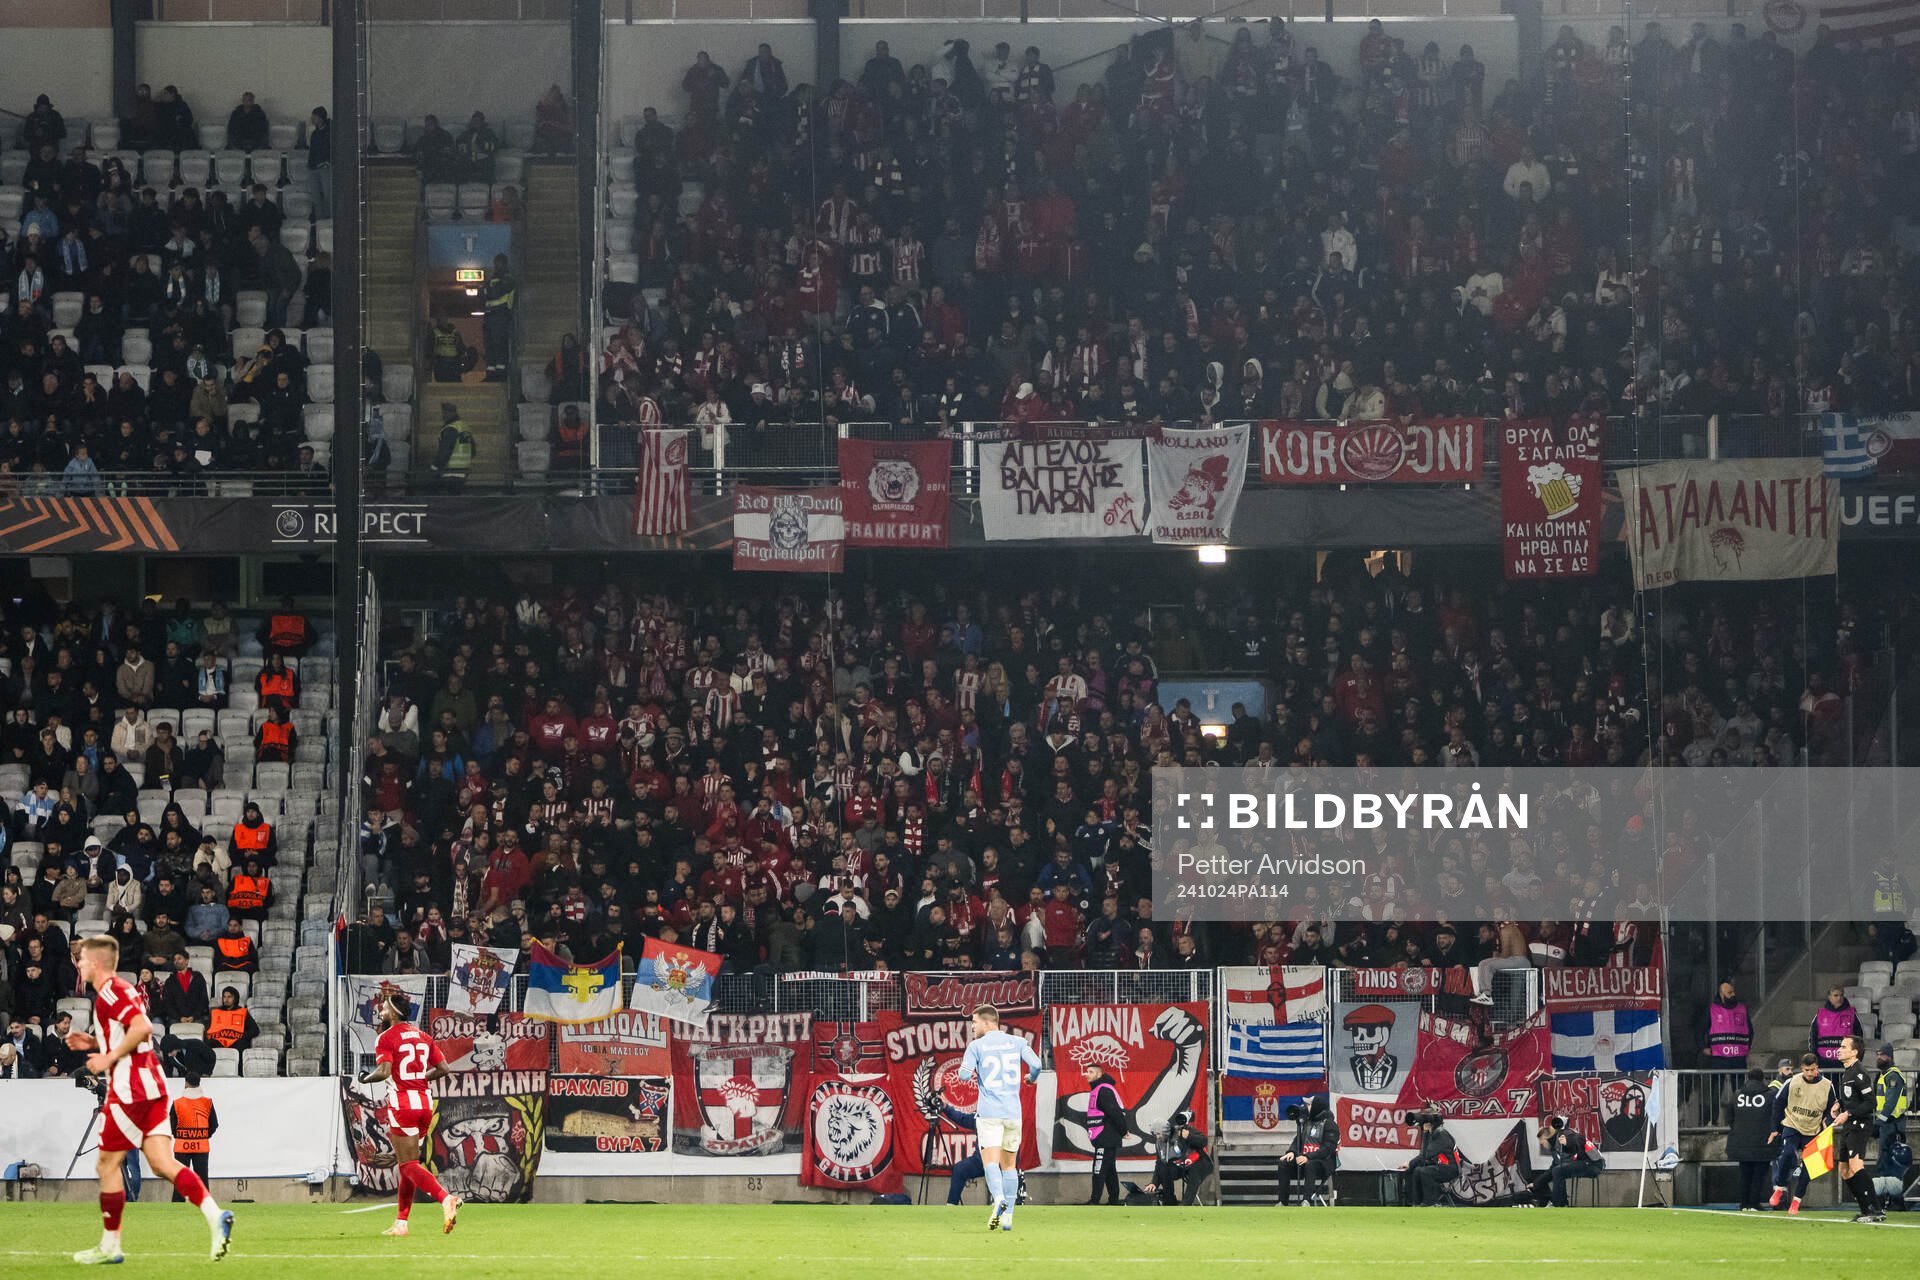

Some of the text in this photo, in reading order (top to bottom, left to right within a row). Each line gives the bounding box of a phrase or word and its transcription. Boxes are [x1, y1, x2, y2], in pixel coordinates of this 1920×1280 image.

[1506, 427, 1589, 444] ΘΡΥΛ ΟΛ
[737, 495, 769, 510] Red
[797, 494, 843, 513] Death
[1639, 475, 1828, 551] ΑΤΑΛΑΝΤΗ
[1841, 495, 1920, 526] UEF
[314, 512, 427, 535] RPECT
[842, 521, 943, 541] FRANKFURT
[1506, 522, 1530, 538] ΚΑΙ
[831, 544, 841, 559] 7
[1520, 540, 1558, 556] ΗΡΘΑ
[1514, 559, 1537, 574] ΝΑ
[1544, 558, 1564, 573] ΣΕ
[1357, 970, 1397, 990] TINOS
[1548, 967, 1661, 997] MEGALOPOLI
[905, 974, 1034, 1018] Rethymno
[208, 1030, 244, 1040] TEWAR
[432, 1014, 547, 1042] Moshato
[1052, 1006, 1144, 1049] KAMINIA
[887, 1020, 1035, 1061] STOCKM
[398, 1042, 430, 1081] 23
[981, 1052, 1021, 1088] 25
[429, 1071, 547, 1098] ΑΙΣΑΡΙΑΝΗ
[548, 1078, 629, 1097] ΗΡΑΚΛΕΙΟ
[1540, 1077, 1602, 1112] KAST
[1436, 1098, 1505, 1115] ΥΡΑ
[1508, 1088, 1533, 1114] 7
[1737, 1093, 1766, 1108] SLO
[176, 1129, 208, 1139] TEWAR
[596, 1136, 645, 1152] ΘΥΡΑ
[649, 1138, 662, 1152] 7
[1348, 1126, 1419, 1147] ΘΥΡΑ 7
[182, 1141, 201, 1150] 081
[819, 1157, 876, 1182] GATE 7
[236, 1179, 249, 1192] 81
[747, 1177, 763, 1192] 83
